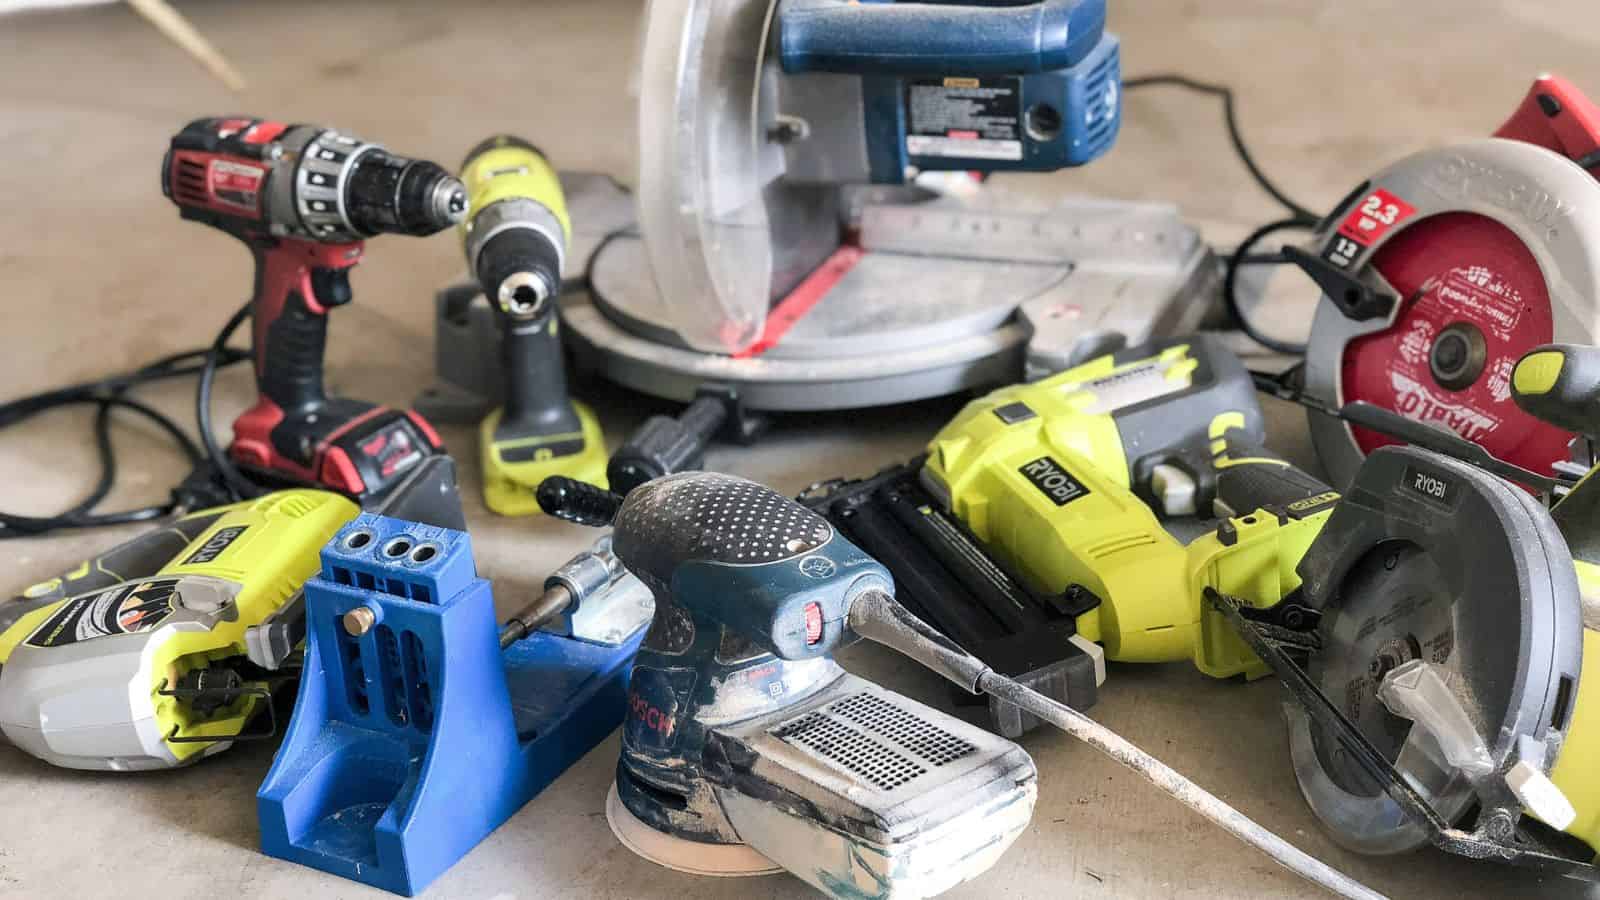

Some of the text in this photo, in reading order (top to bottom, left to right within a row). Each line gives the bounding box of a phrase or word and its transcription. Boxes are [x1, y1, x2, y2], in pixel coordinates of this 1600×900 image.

[1361, 195, 1399, 225] 2.3
[1025, 458, 1083, 502] RYOBI
[1415, 473, 1447, 498] RYOBI
